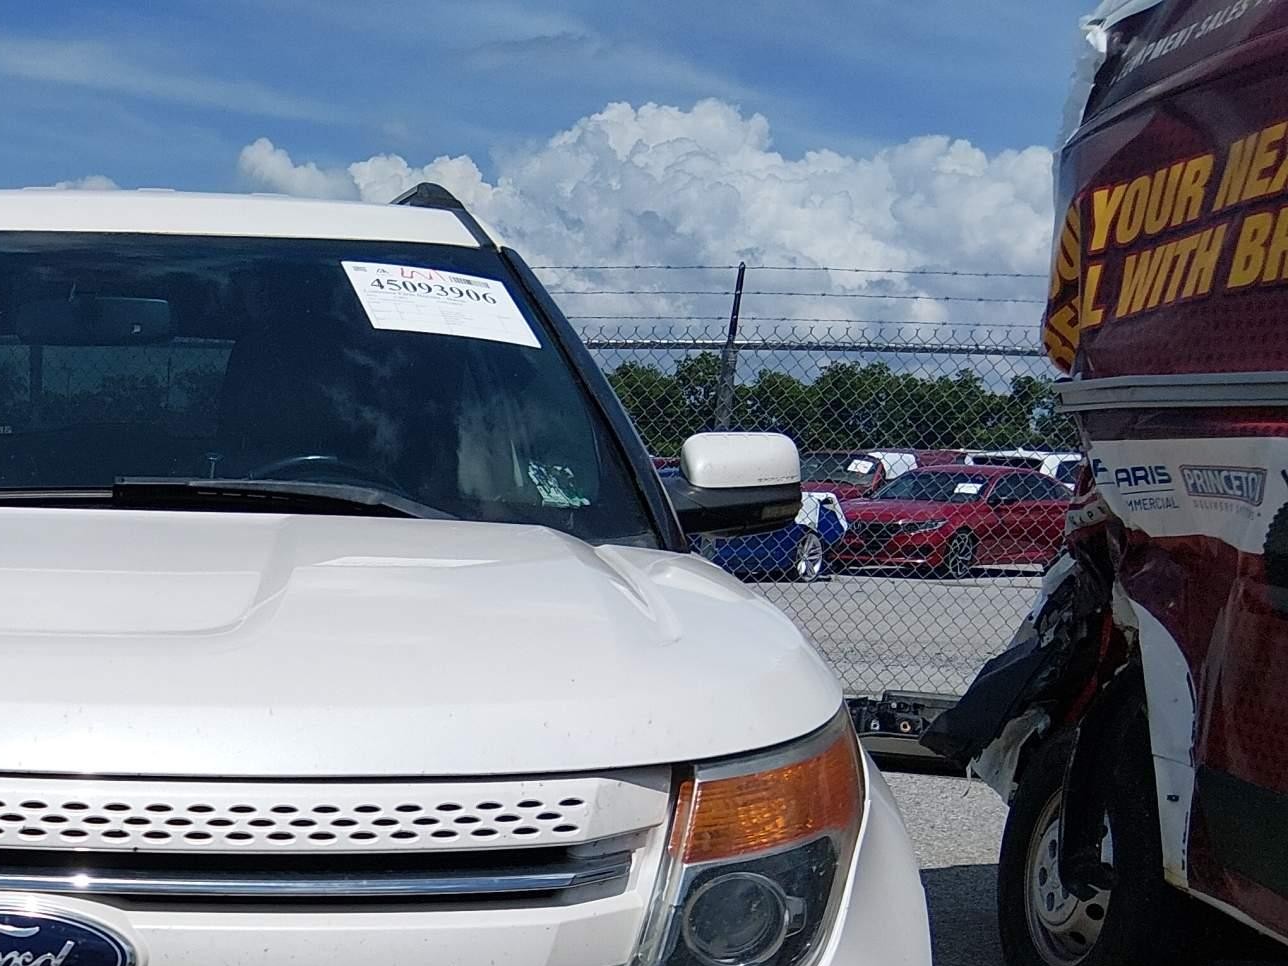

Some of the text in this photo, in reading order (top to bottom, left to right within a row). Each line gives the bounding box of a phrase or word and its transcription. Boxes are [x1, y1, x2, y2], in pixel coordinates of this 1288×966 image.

[1090, 153, 1215, 251] YOUR
[370, 278, 497, 305] 45093906
[1116, 223, 1228, 318] WITH
